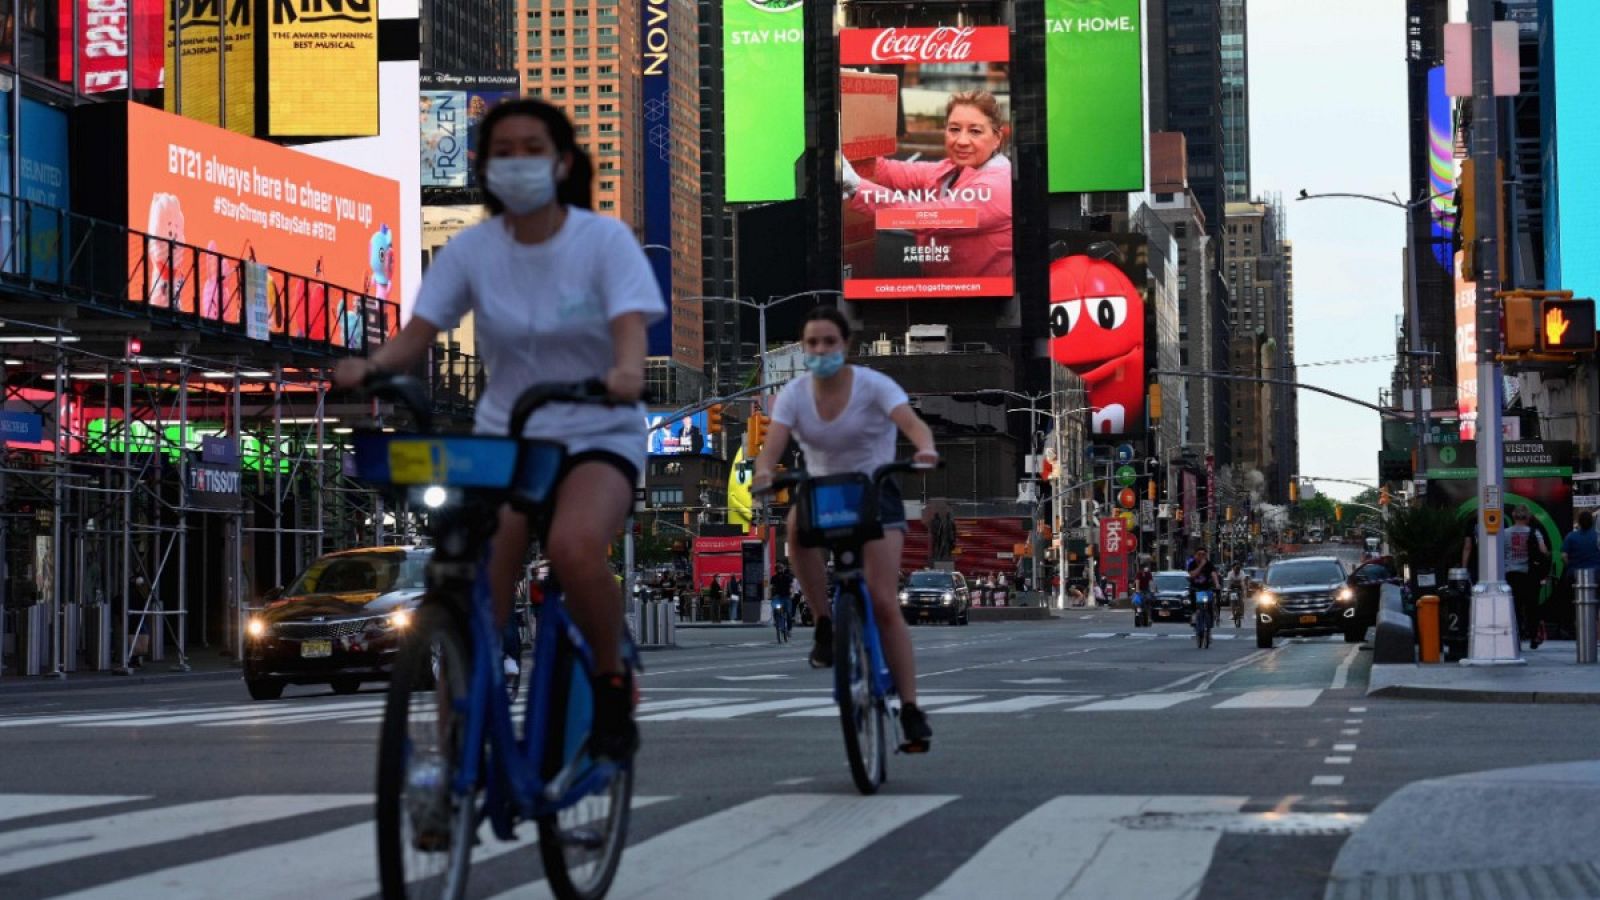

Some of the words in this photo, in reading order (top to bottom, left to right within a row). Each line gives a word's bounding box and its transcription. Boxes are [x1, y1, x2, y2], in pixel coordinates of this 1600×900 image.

[1077, 16, 1135, 32] HOME,
[643, 0, 668, 76] NOV
[731, 30, 769, 45] STAY
[774, 29, 804, 43] HO
[871, 26, 976, 61] Coca-Cola
[464, 75, 477, 84] ON
[478, 75, 517, 84] BROADWAY
[432, 95, 461, 180] FROZEN
[168, 144, 202, 180] BT21
[204, 155, 251, 197] always
[253, 166, 282, 201] here
[284, 177, 297, 205] to
[300, 181, 333, 214] cheer
[335, 195, 356, 221] you
[358, 203, 373, 229] up
[861, 188, 938, 204] THANK
[946, 187, 992, 203] YOU
[213, 196, 268, 229] #StayStrong
[269, 211, 311, 236] #StaySafe
[312, 221, 336, 242] #BT21
[903, 243, 951, 254] FEEDING
[903, 254, 950, 263] AMERICA
[875, 282, 981, 293] coke.com/togetherwecan
[1504, 443, 1545, 453] VISITOR
[1504, 455, 1553, 464] SERVICES
[204, 469, 240, 493] TISSOT
[1449, 612, 1459, 631] 2
